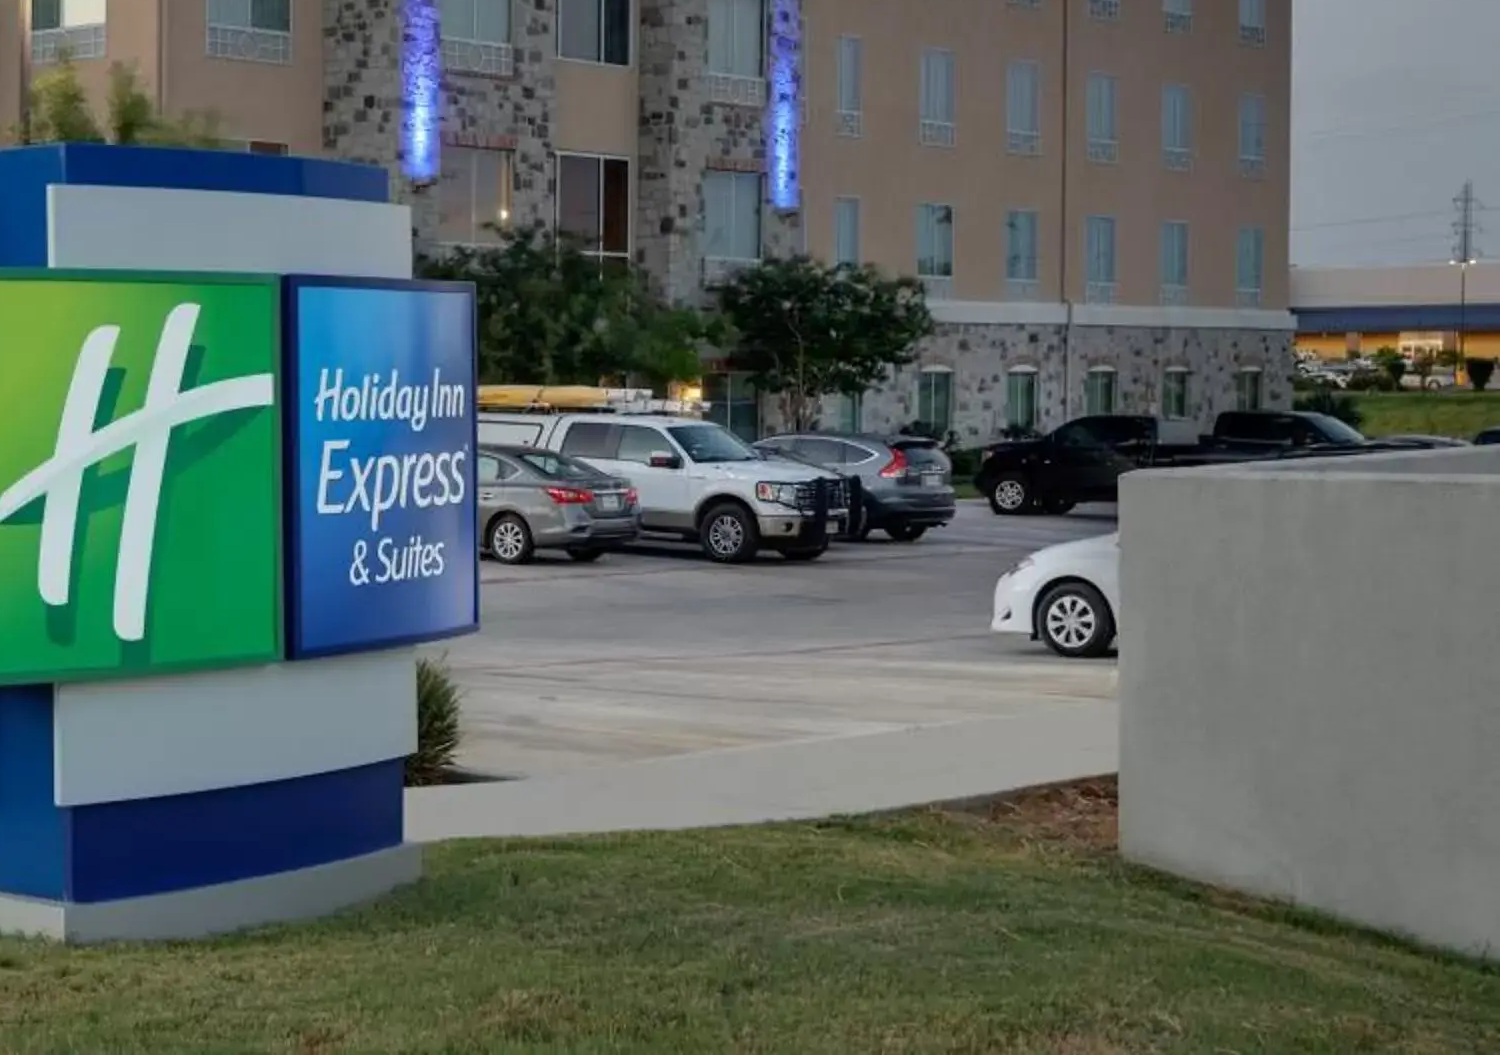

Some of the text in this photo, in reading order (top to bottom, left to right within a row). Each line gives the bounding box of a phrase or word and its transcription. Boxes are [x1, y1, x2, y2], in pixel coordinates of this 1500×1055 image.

[314, 367, 465, 431] Holiday Inn
[317, 439, 465, 532] Express
[350, 535, 444, 586] & Suites
